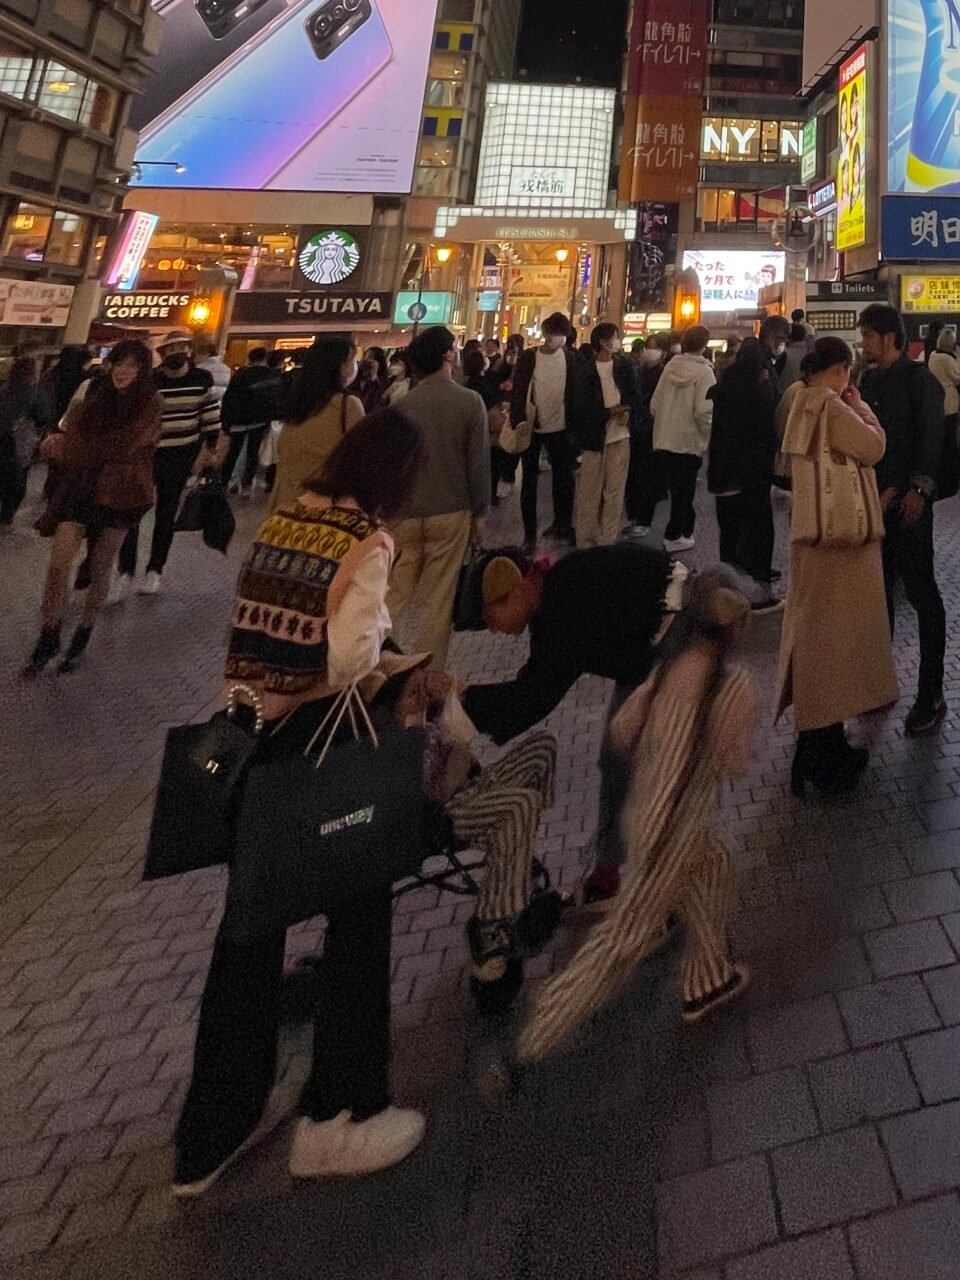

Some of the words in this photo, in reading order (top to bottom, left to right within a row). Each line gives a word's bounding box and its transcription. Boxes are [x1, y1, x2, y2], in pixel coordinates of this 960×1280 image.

[703, 125, 757, 154] NY
[812, 181, 836, 210] LOTTERIA
[694, 260, 725, 271] たった
[844, 283, 875, 293] Toilets
[104, 295, 190, 306] TARBUCKS
[286, 297, 382, 314] TSUTAYA
[106, 307, 170, 318] COFFEE
